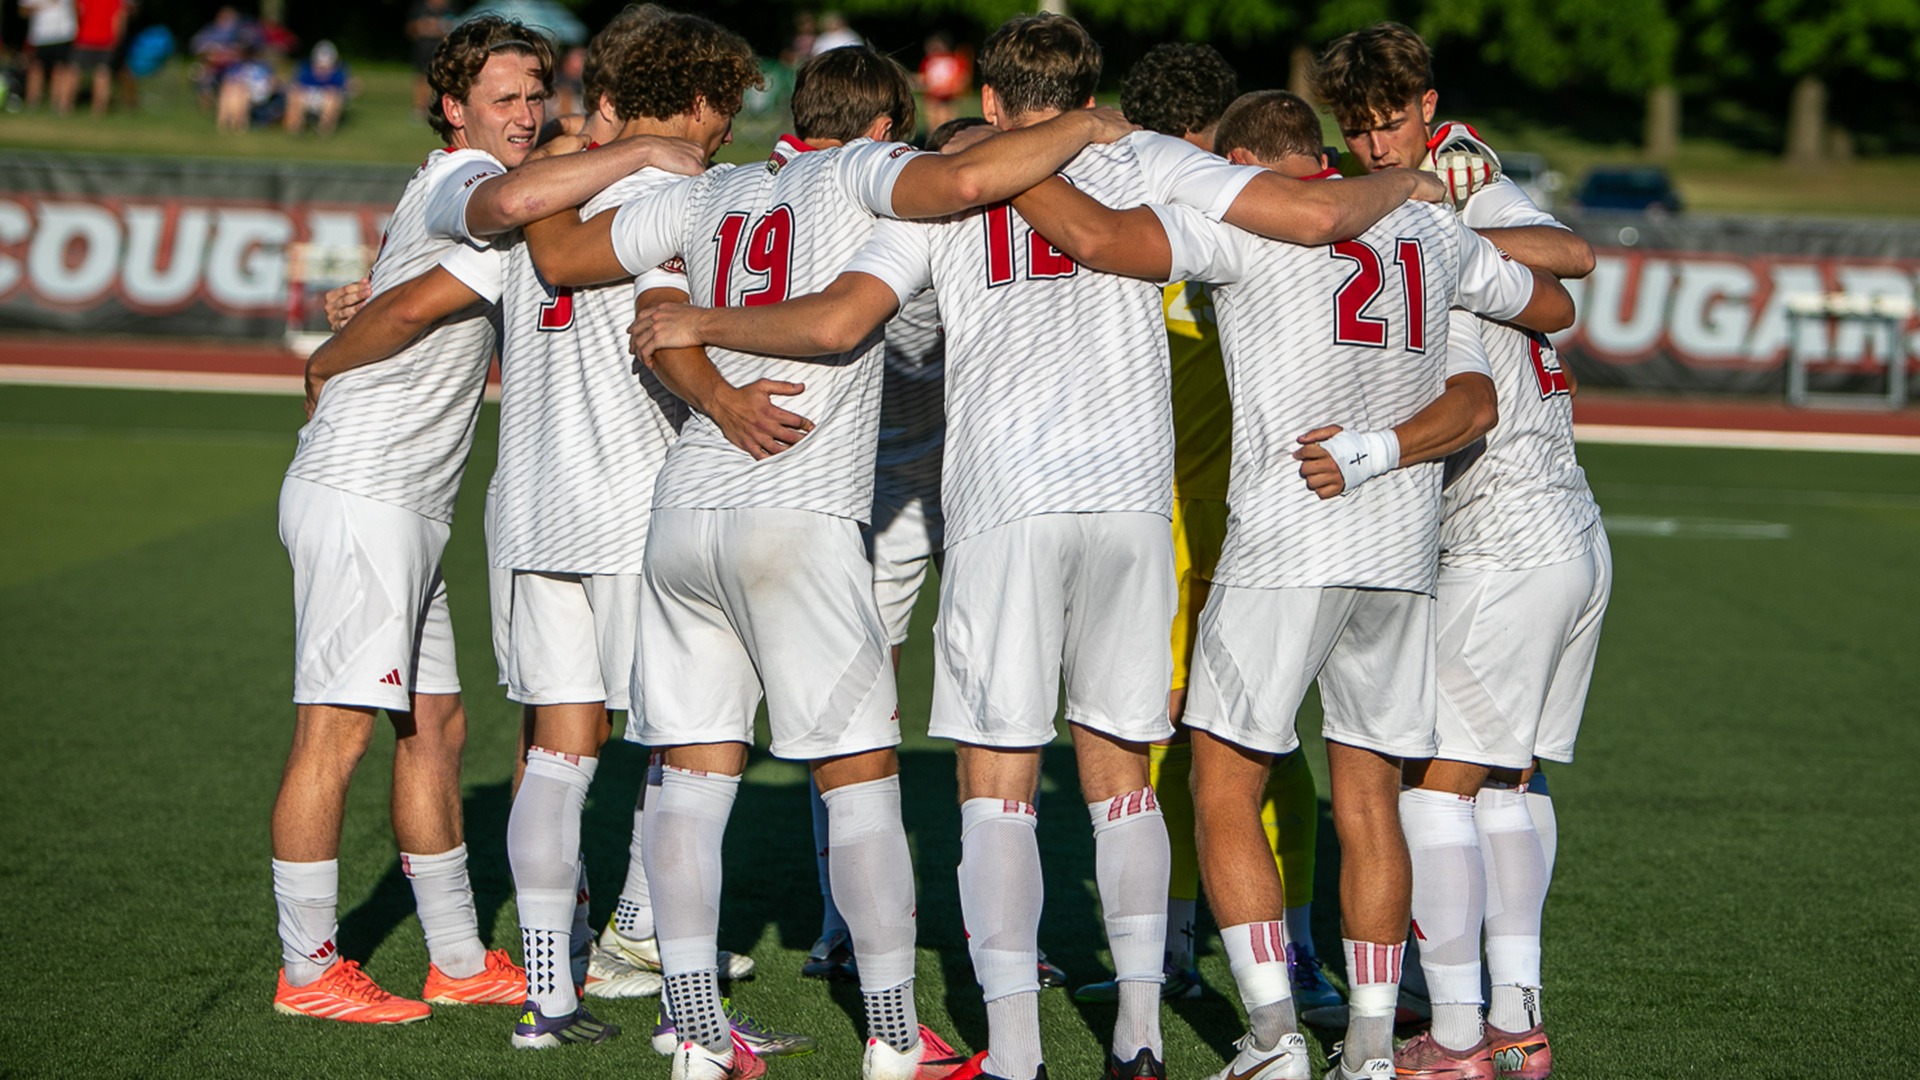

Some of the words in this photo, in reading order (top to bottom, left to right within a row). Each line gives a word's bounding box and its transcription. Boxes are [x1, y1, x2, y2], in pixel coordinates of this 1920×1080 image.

[711, 202, 795, 308] 19
[1329, 237, 1427, 355] 21
[1550, 254, 1920, 363] UGAR
